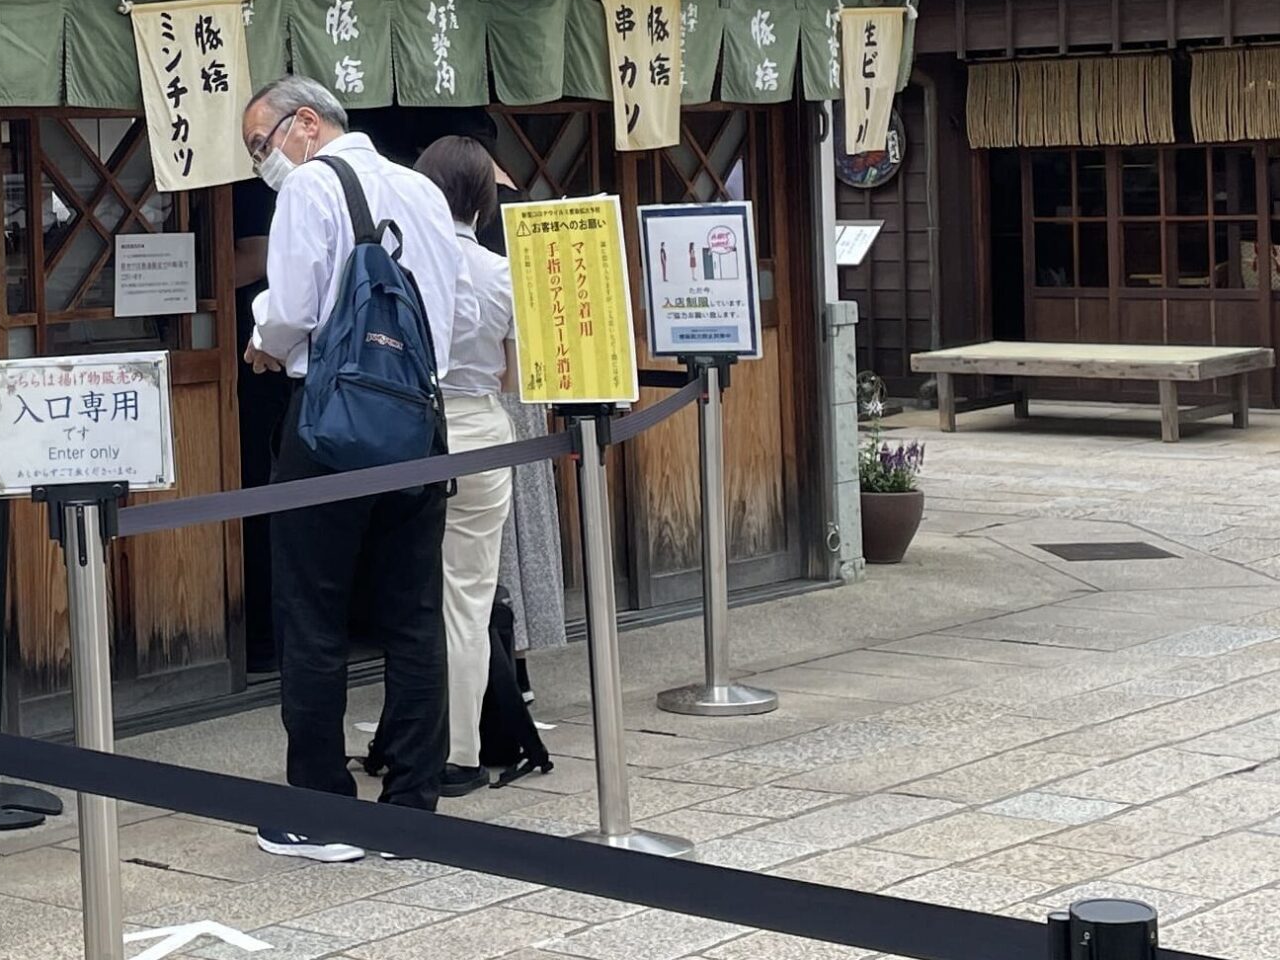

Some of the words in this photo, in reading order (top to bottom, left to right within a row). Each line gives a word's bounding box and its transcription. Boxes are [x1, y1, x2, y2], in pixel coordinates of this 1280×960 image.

[194, 14, 230, 94] 豚捨
[647, 4, 671, 87] 豚捨
[750, 8, 779, 92] 豚捨
[159, 11, 194, 178] ミンチカツ
[531, 218, 607, 234] お客様へのお願い
[546, 241, 573, 391] 手指のアルコール消毒
[571, 240, 593, 338] マスクの着用
[12, 389, 139, 425] 入口専用
[63, 426, 90, 441] です
[48, 446, 85, 461] Enter
[89, 445, 120, 461] only
